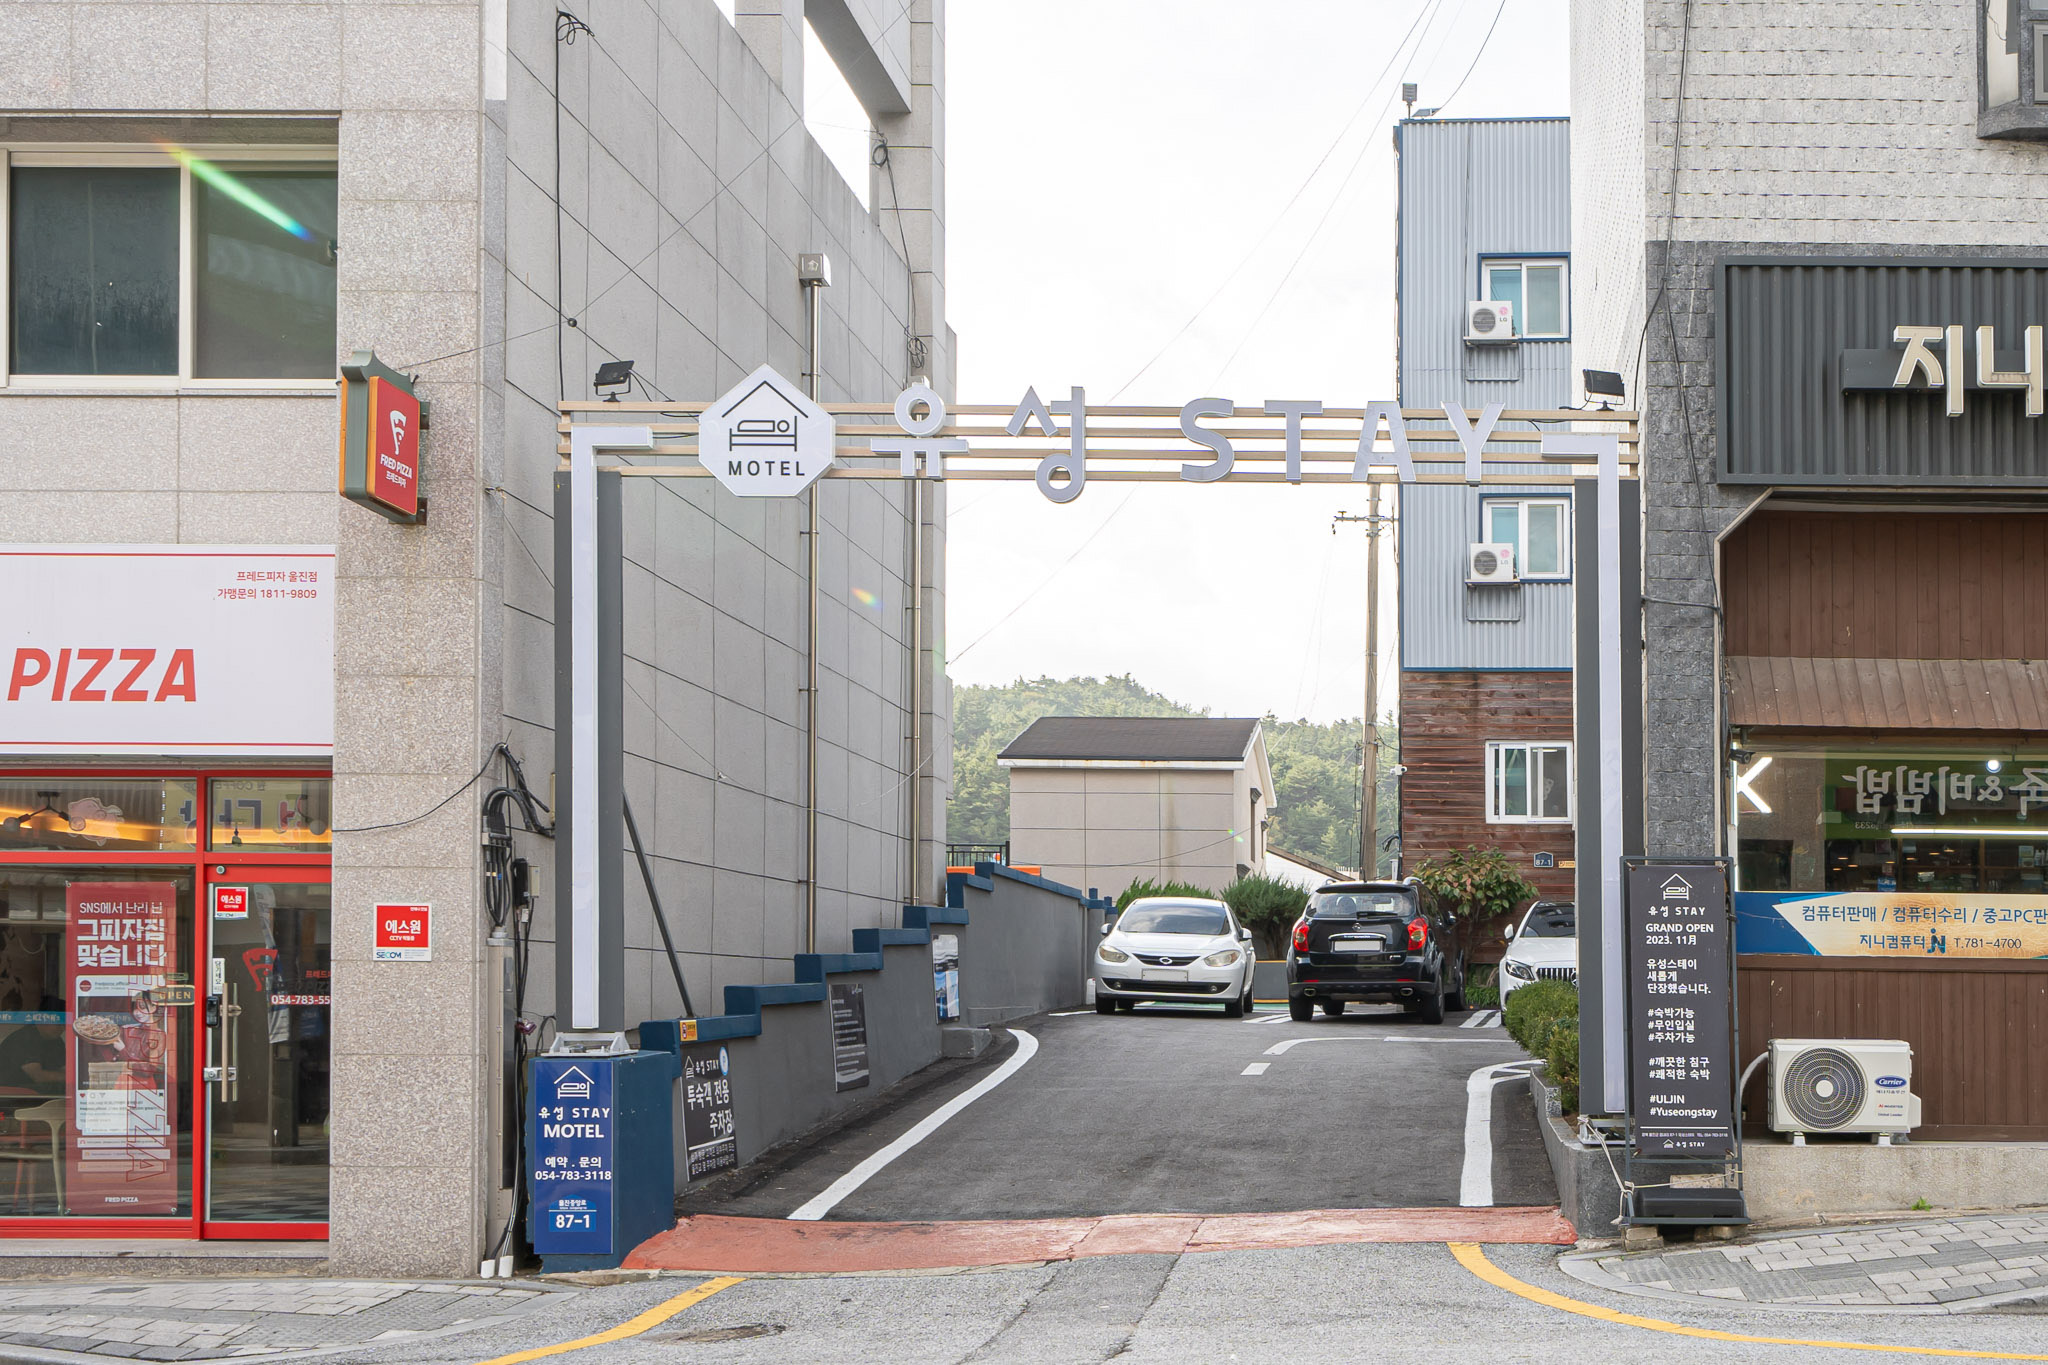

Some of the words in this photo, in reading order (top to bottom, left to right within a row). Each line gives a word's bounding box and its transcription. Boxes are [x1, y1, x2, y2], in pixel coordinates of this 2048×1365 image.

[1893, 325, 2043, 417] 지니
[870, 378, 1086, 504] 유성
[1180, 397, 1505, 485] STAY
[380, 453, 396, 470] FRED
[396, 461, 412, 479] PIZZA
[728, 460, 805, 476] MOTEL
[236, 571, 285, 582] 프레드피자
[288, 571, 318, 583] 울진점
[218, 588, 257, 600] 가맹문의
[260, 589, 317, 599] 1811-9809
[7, 648, 197, 702] PIZZA
[221, 895, 242, 904] 에스원
[80, 902, 122, 914] SNS에서
[126, 902, 148, 914] 난리
[1648, 906, 1669, 918] 유성
[1675, 906, 1706, 916] STAY
[1802, 905, 1877, 923] 컴퓨터판매
[1892, 906, 1967, 924] 컴퓨터수리
[1982, 907, 2048, 925] 중고PC판
[77, 919, 165, 941] 그피자집
[385, 919, 421, 934] 에스원
[1645, 923, 1683, 933] GRAND
[1685, 923, 1714, 933] OPEN
[1646, 935, 1673, 945] 2023.
[1676, 934, 1697, 946] 11月
[1859, 934, 1926, 949] 지니컴퓨터
[1954, 937, 2022, 949] T.781-4700
[77, 944, 168, 967] 맞습니다
[376, 951, 402, 959] SECOM
[1646, 958, 1697, 970] 유성스테이
[1647, 970, 1678, 982] 새롭게
[1647, 983, 1712, 994] 단장했습니다.
[271, 995, 331, 1005] 054-783-55
[1647, 1007, 1695, 1019] #숙박가능
[1648, 1020, 1695, 1031] #무인입실
[1648, 1032, 1696, 1043] #주차가능
[706, 1059, 719, 1071] STAY
[1649, 1056, 1686, 1068] #깨끗한
[1689, 1056, 1710, 1068] 침구
[1649, 1069, 1686, 1080] #쾌적한
[1689, 1069, 1711, 1080] 숙박
[1878, 1078, 1904, 1086] Carrier
[687, 1081, 713, 1111] 투숙객
[714, 1079, 730, 1105] 전용
[1649, 1094, 1685, 1104] #ULJIN
[126, 1026, 166, 1182] PIZZA
[538, 1106, 564, 1121] 유성
[571, 1107, 611, 1119] STAY
[1649, 1107, 1718, 1119] #Yuseongstay
[710, 1108, 733, 1137] 주차장
[543, 1124, 604, 1138] MOTEL
[545, 1156, 568, 1168] 예약
[579, 1156, 601, 1168] 문의
[535, 1170, 612, 1180] 054-783-3118
[555, 1214, 590, 1228] 87-1
